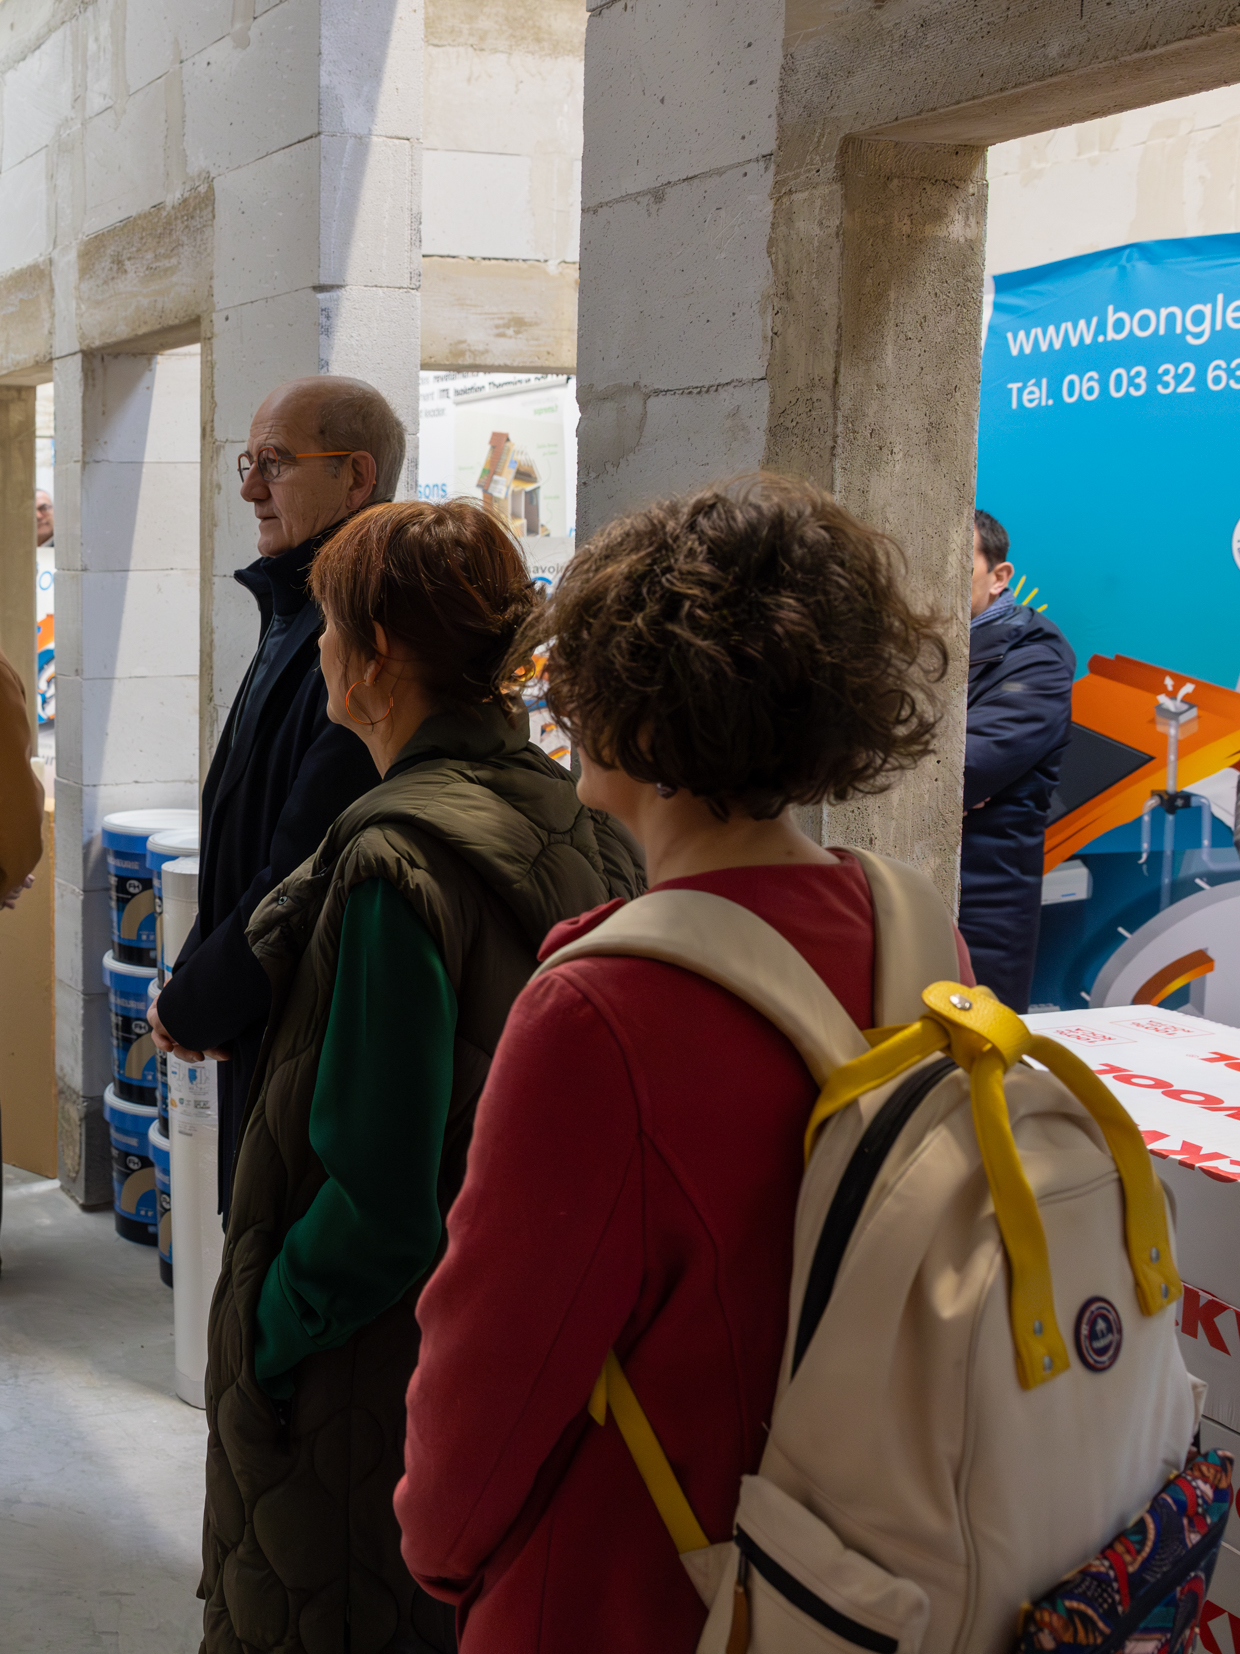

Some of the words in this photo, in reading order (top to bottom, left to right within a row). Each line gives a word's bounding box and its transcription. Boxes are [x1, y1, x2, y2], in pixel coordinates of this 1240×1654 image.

[1006, 293, 1240, 357] www.bongle
[1006, 378, 1054, 409] Tél.
[1061, 371, 1100, 403] 06
[1109, 366, 1147, 398] 03
[1156, 362, 1196, 394] 32
[1207, 357, 1240, 391] 63
